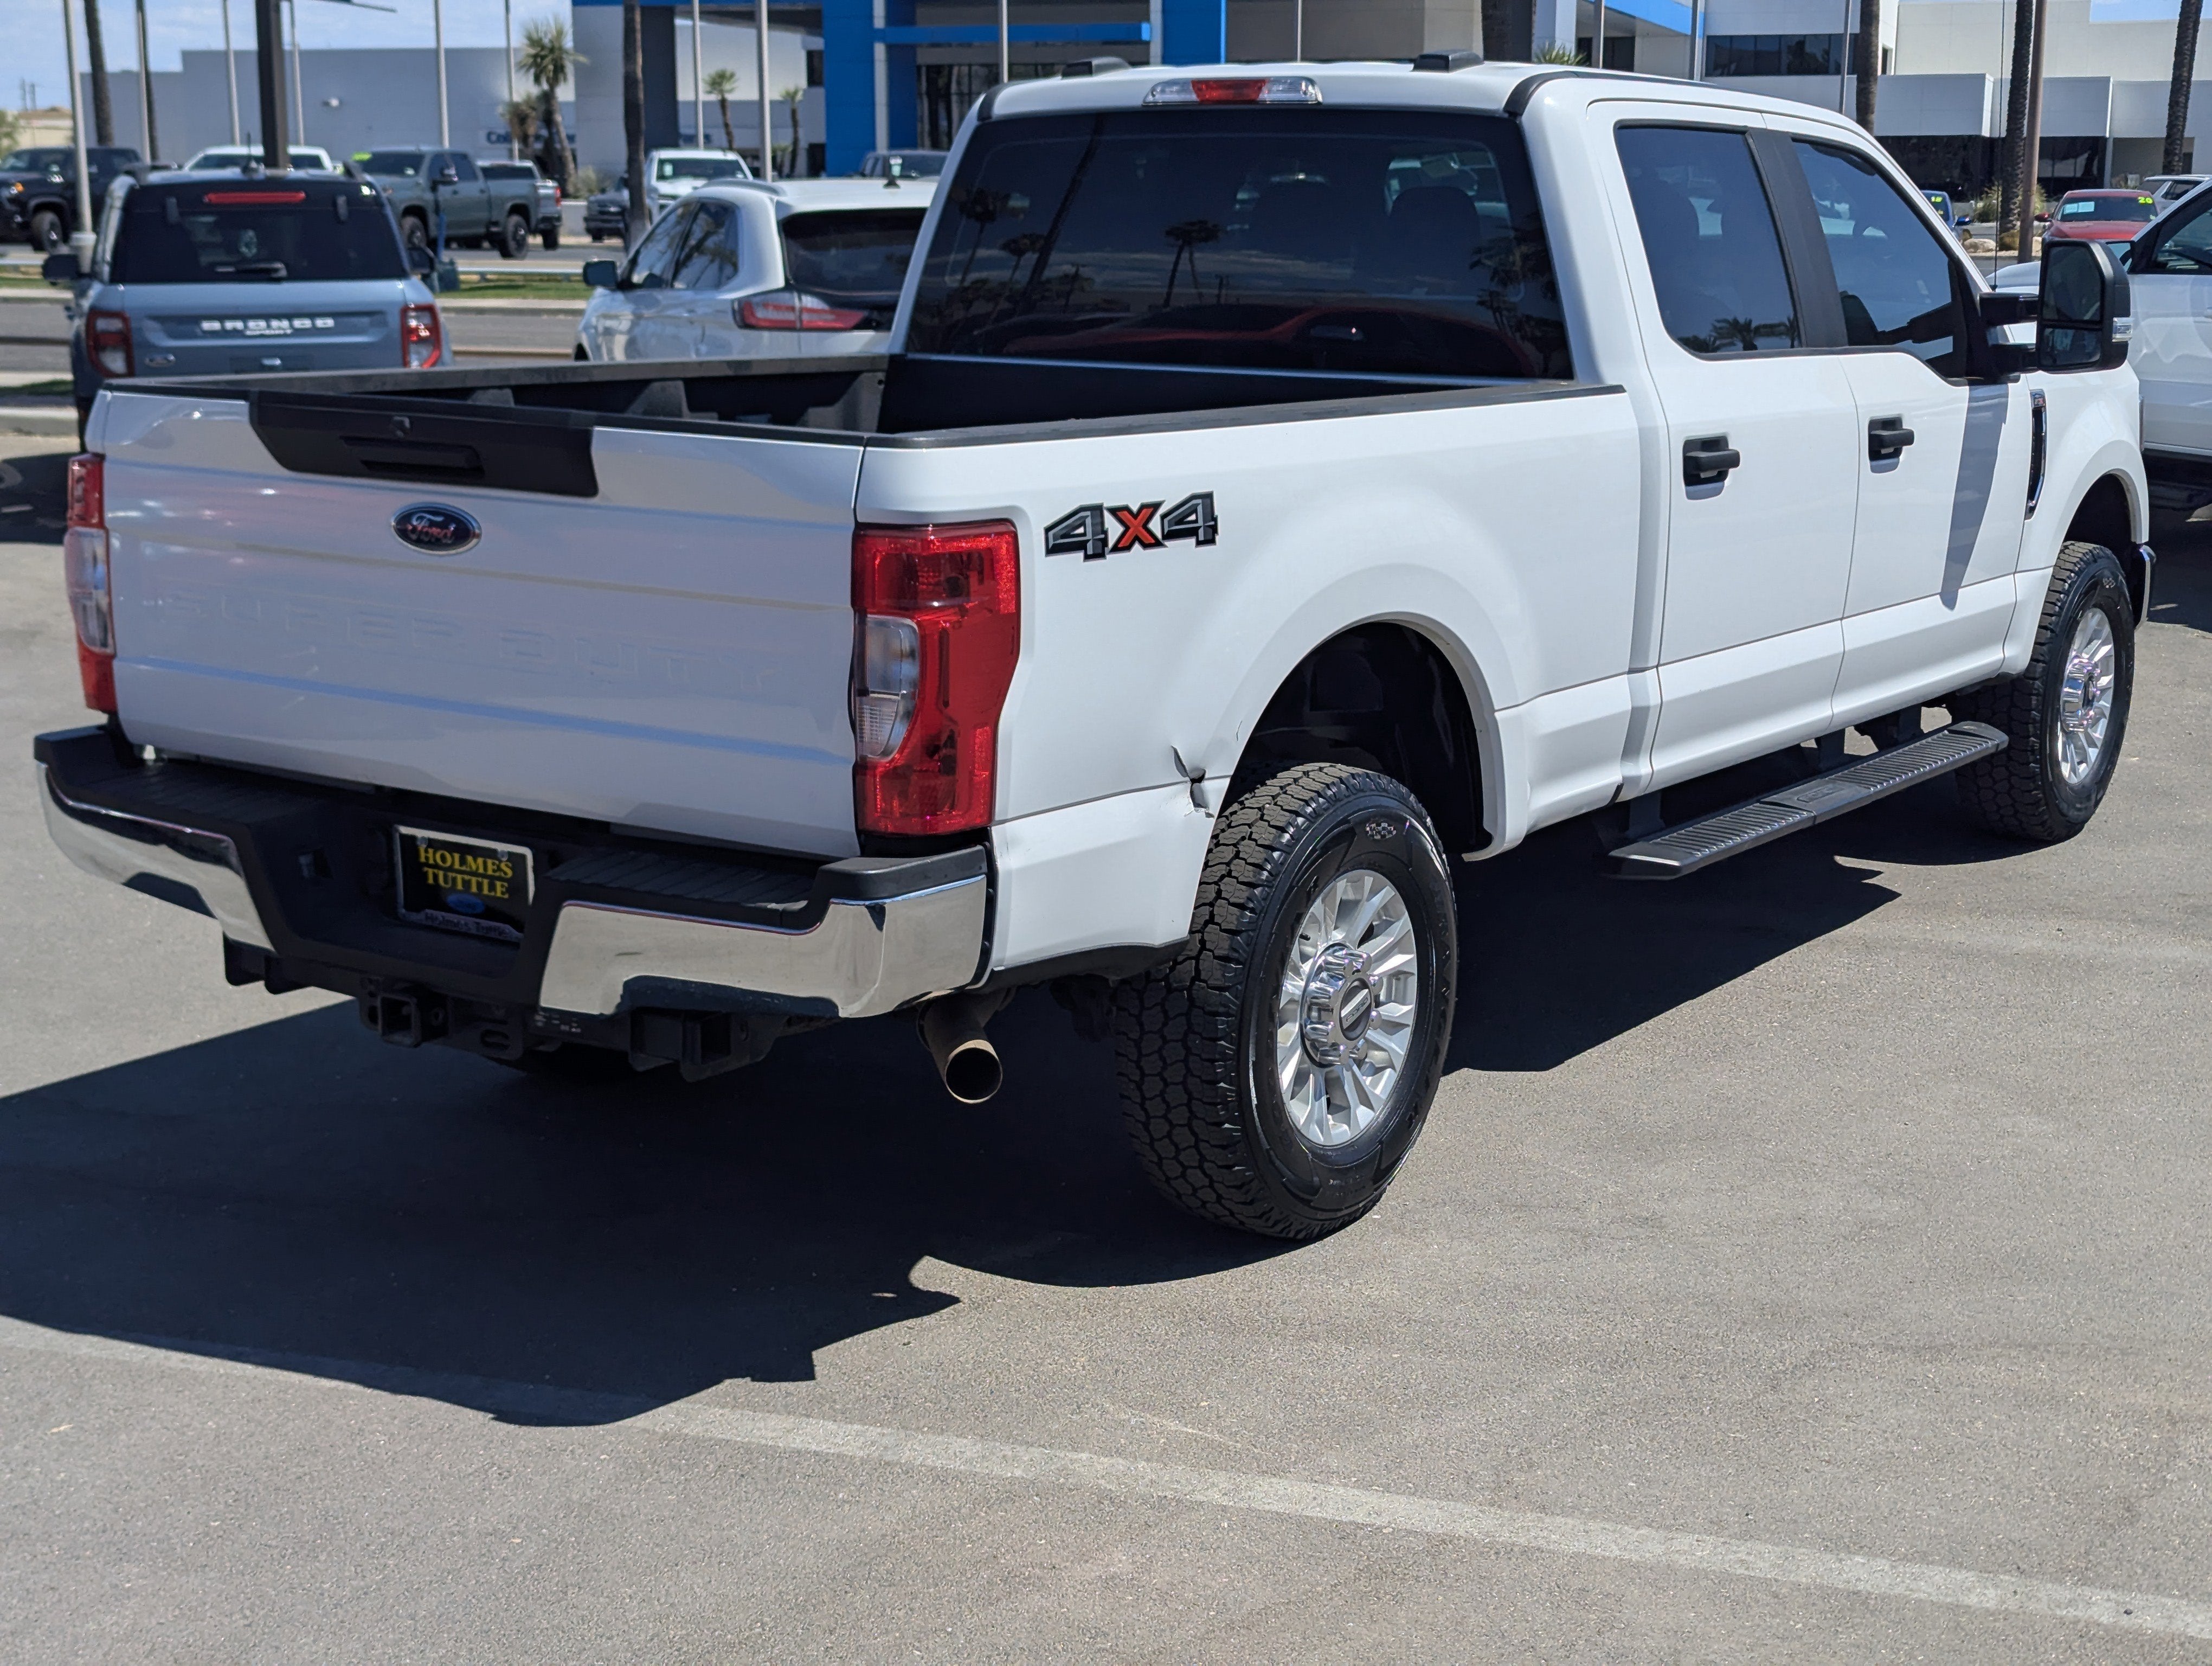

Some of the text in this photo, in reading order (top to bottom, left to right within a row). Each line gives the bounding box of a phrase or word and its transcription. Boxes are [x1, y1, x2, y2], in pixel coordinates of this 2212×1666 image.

[201, 317, 335, 331] BRONCO
[408, 513, 456, 543] Ford
[167, 588, 784, 691] SUPER DUTY
[419, 846, 513, 878] HOLMES
[423, 867, 509, 898] TUTTLE
